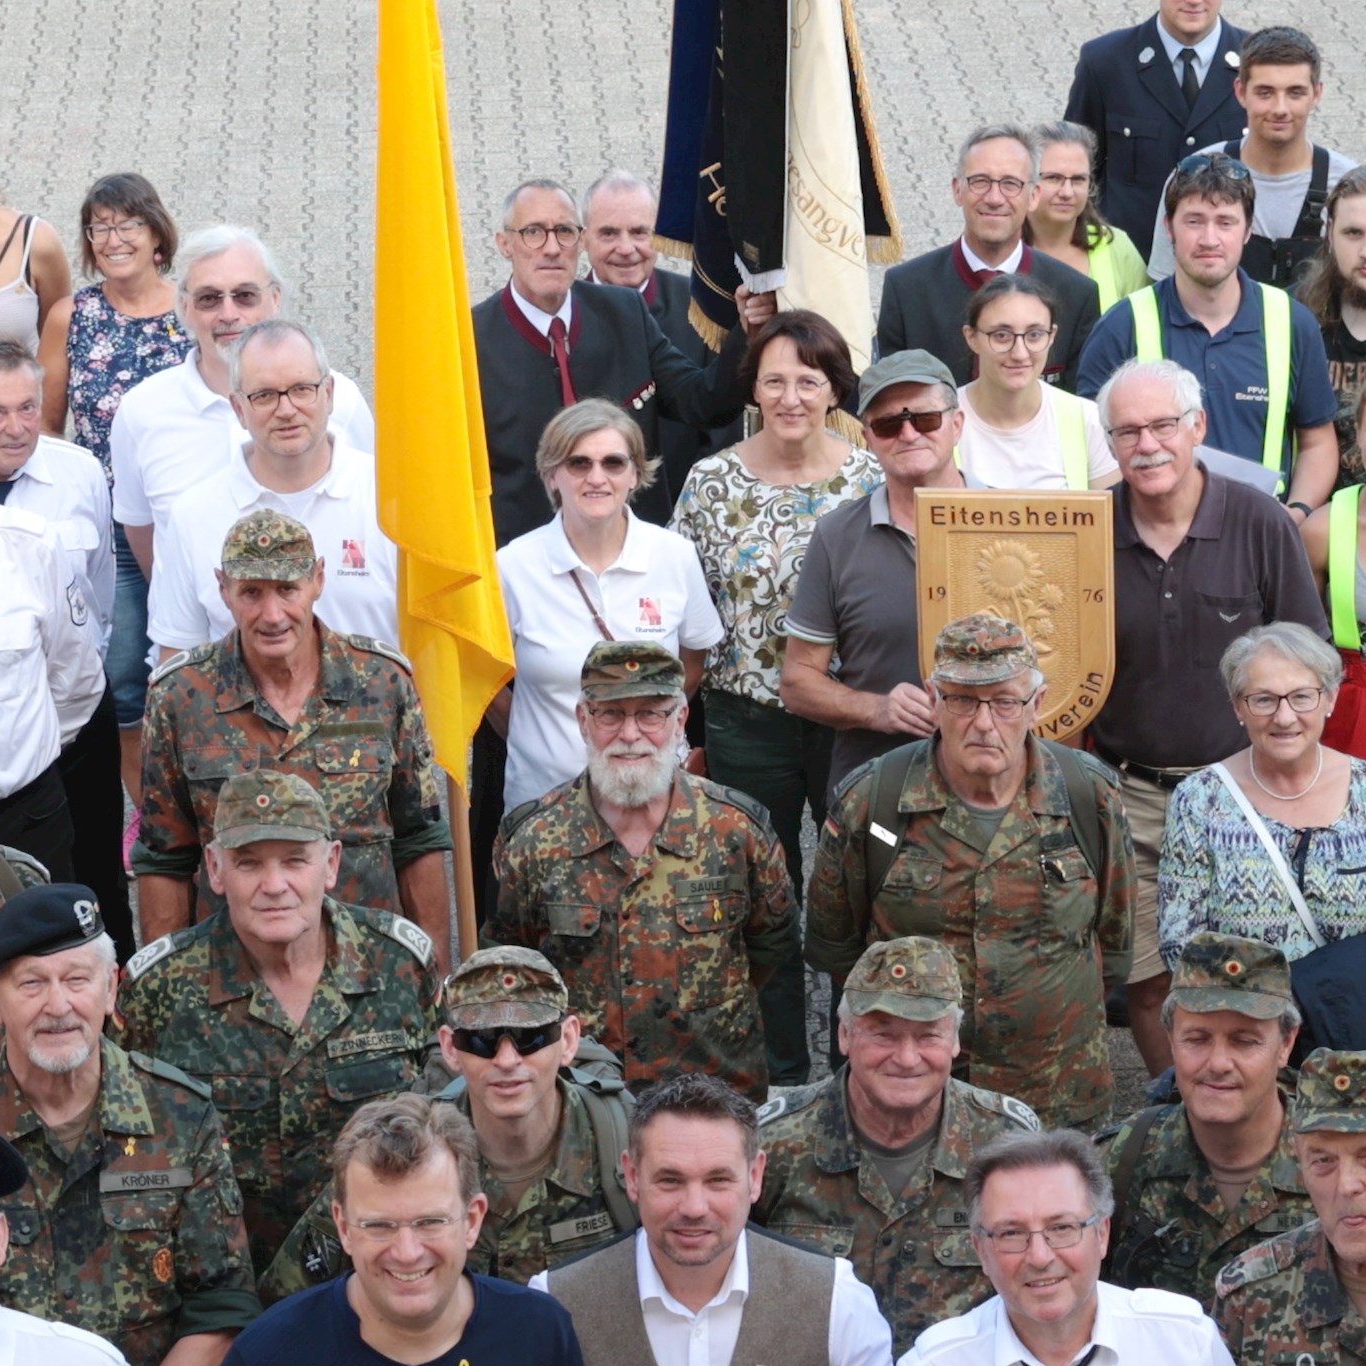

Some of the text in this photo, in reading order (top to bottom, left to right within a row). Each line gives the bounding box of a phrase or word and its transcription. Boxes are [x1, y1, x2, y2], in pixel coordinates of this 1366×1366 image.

[930, 505, 1095, 526] Eitensheim
[927, 586, 946, 600] 19
[1082, 588, 1104, 603] 76
[690, 880, 723, 893] SAULE
[121, 1172, 171, 1188] KRÖNER
[575, 1214, 610, 1234] FRIESE
